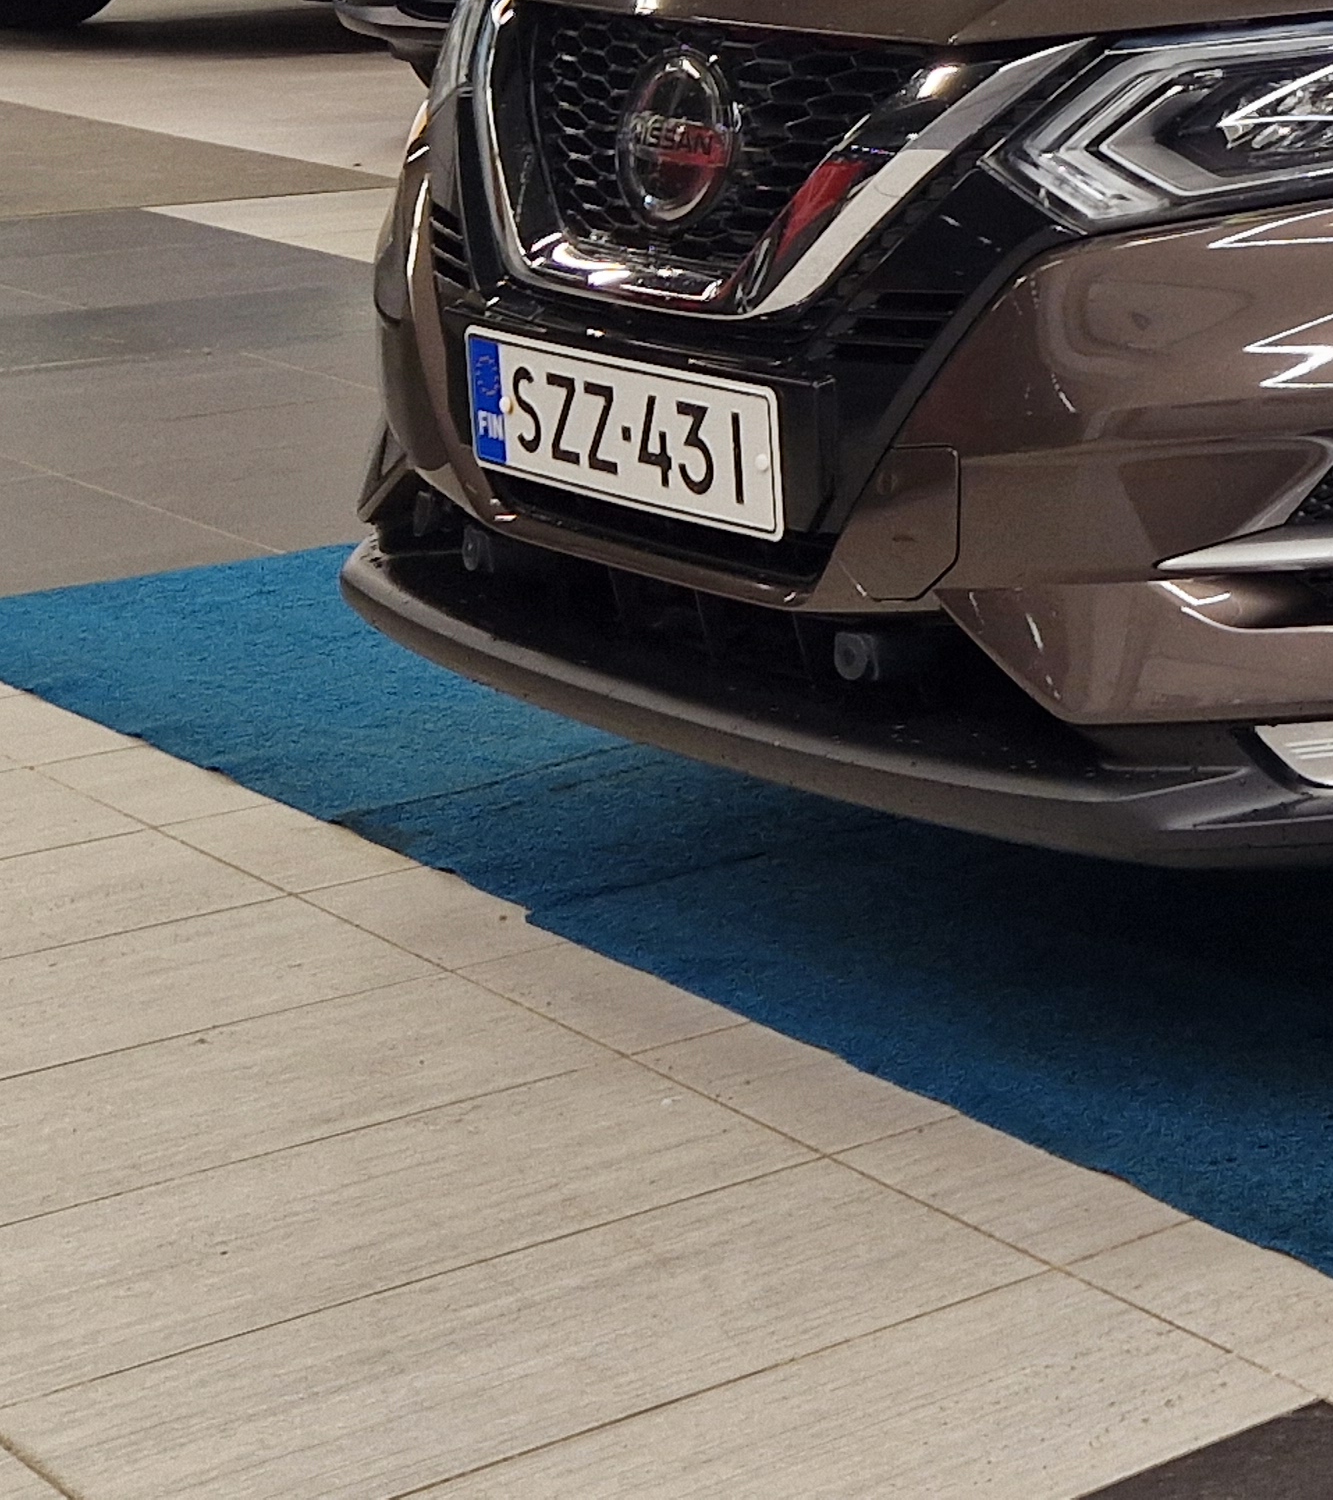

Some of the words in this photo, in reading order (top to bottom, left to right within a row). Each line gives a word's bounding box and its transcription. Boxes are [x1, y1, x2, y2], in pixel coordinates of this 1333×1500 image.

[630, 116, 714, 157] NISSAN
[477, 409, 505, 442] FIN
[512, 365, 745, 506] SZZ-431
